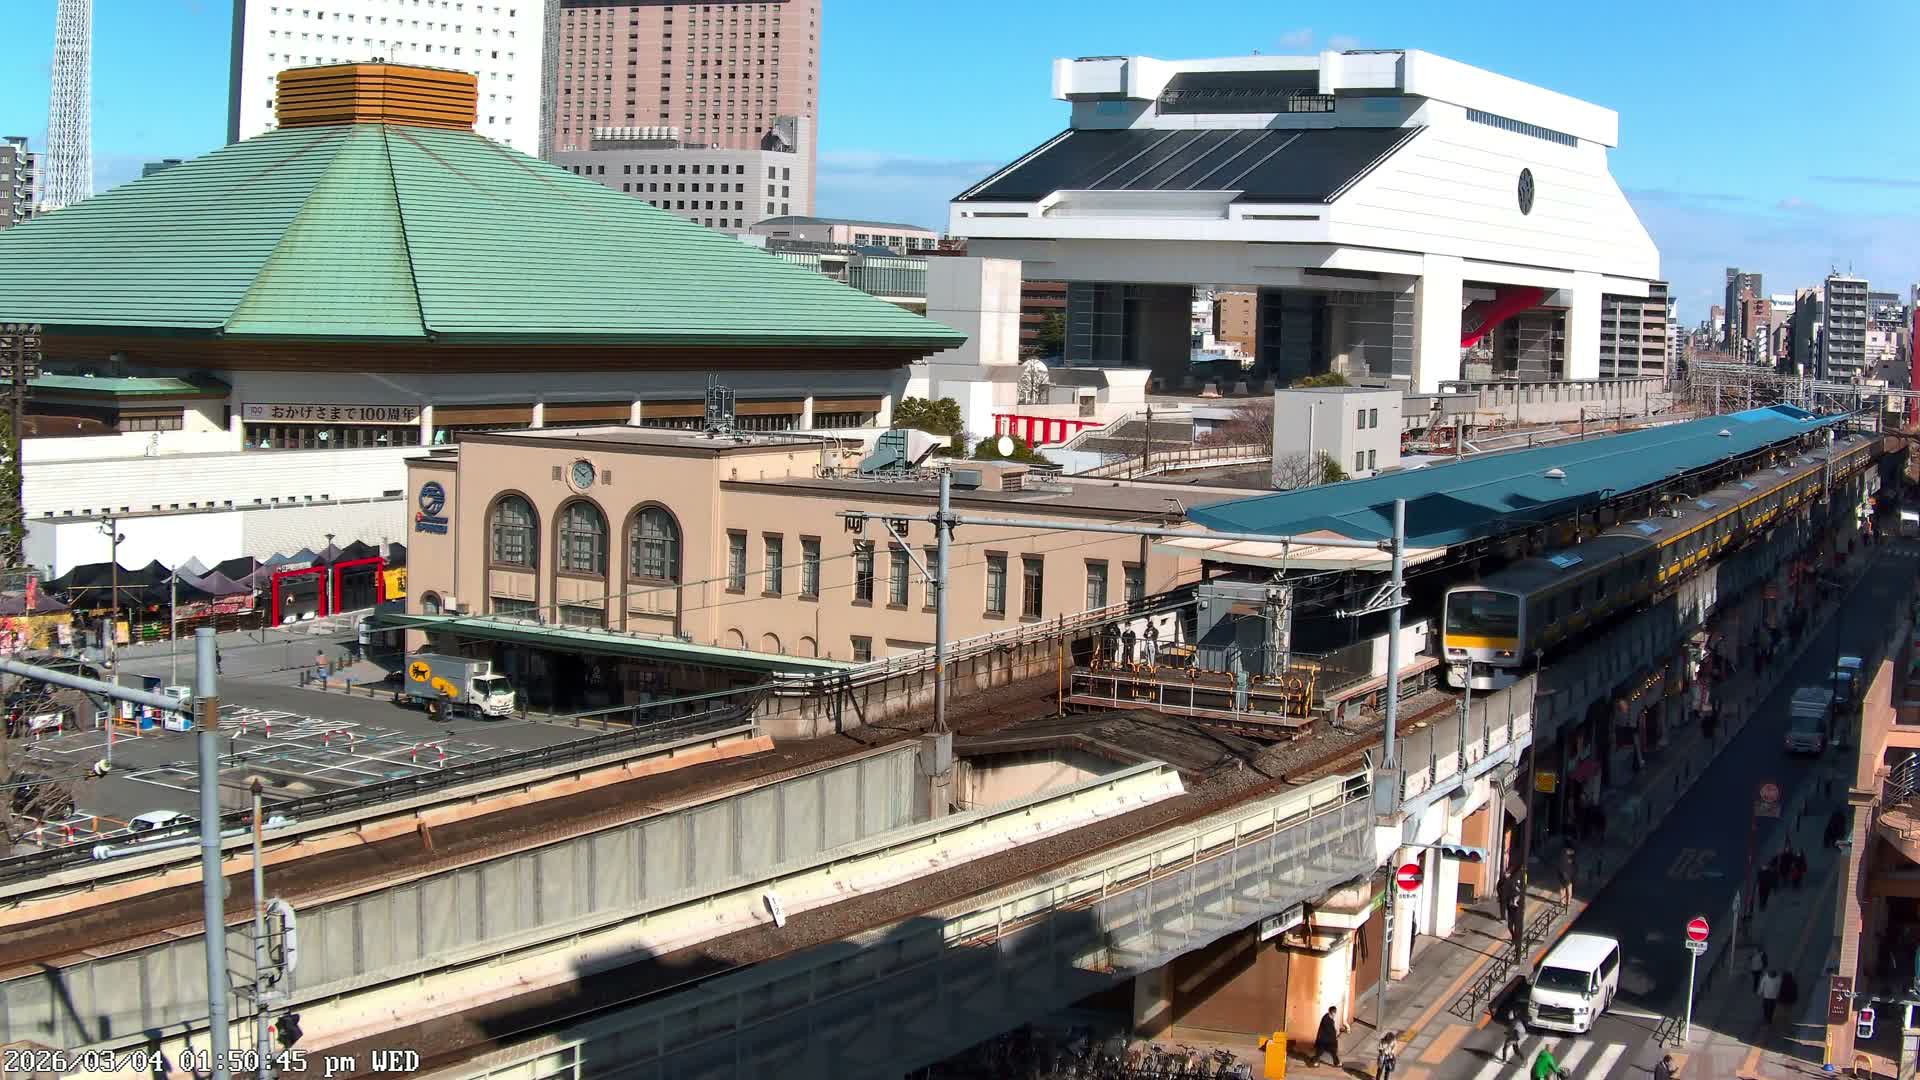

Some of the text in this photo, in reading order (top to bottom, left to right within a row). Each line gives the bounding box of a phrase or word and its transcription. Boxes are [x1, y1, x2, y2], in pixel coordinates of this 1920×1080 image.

[272, 406, 416, 421] おかげさまで100周年
[844, 510, 956, 541] 両国
